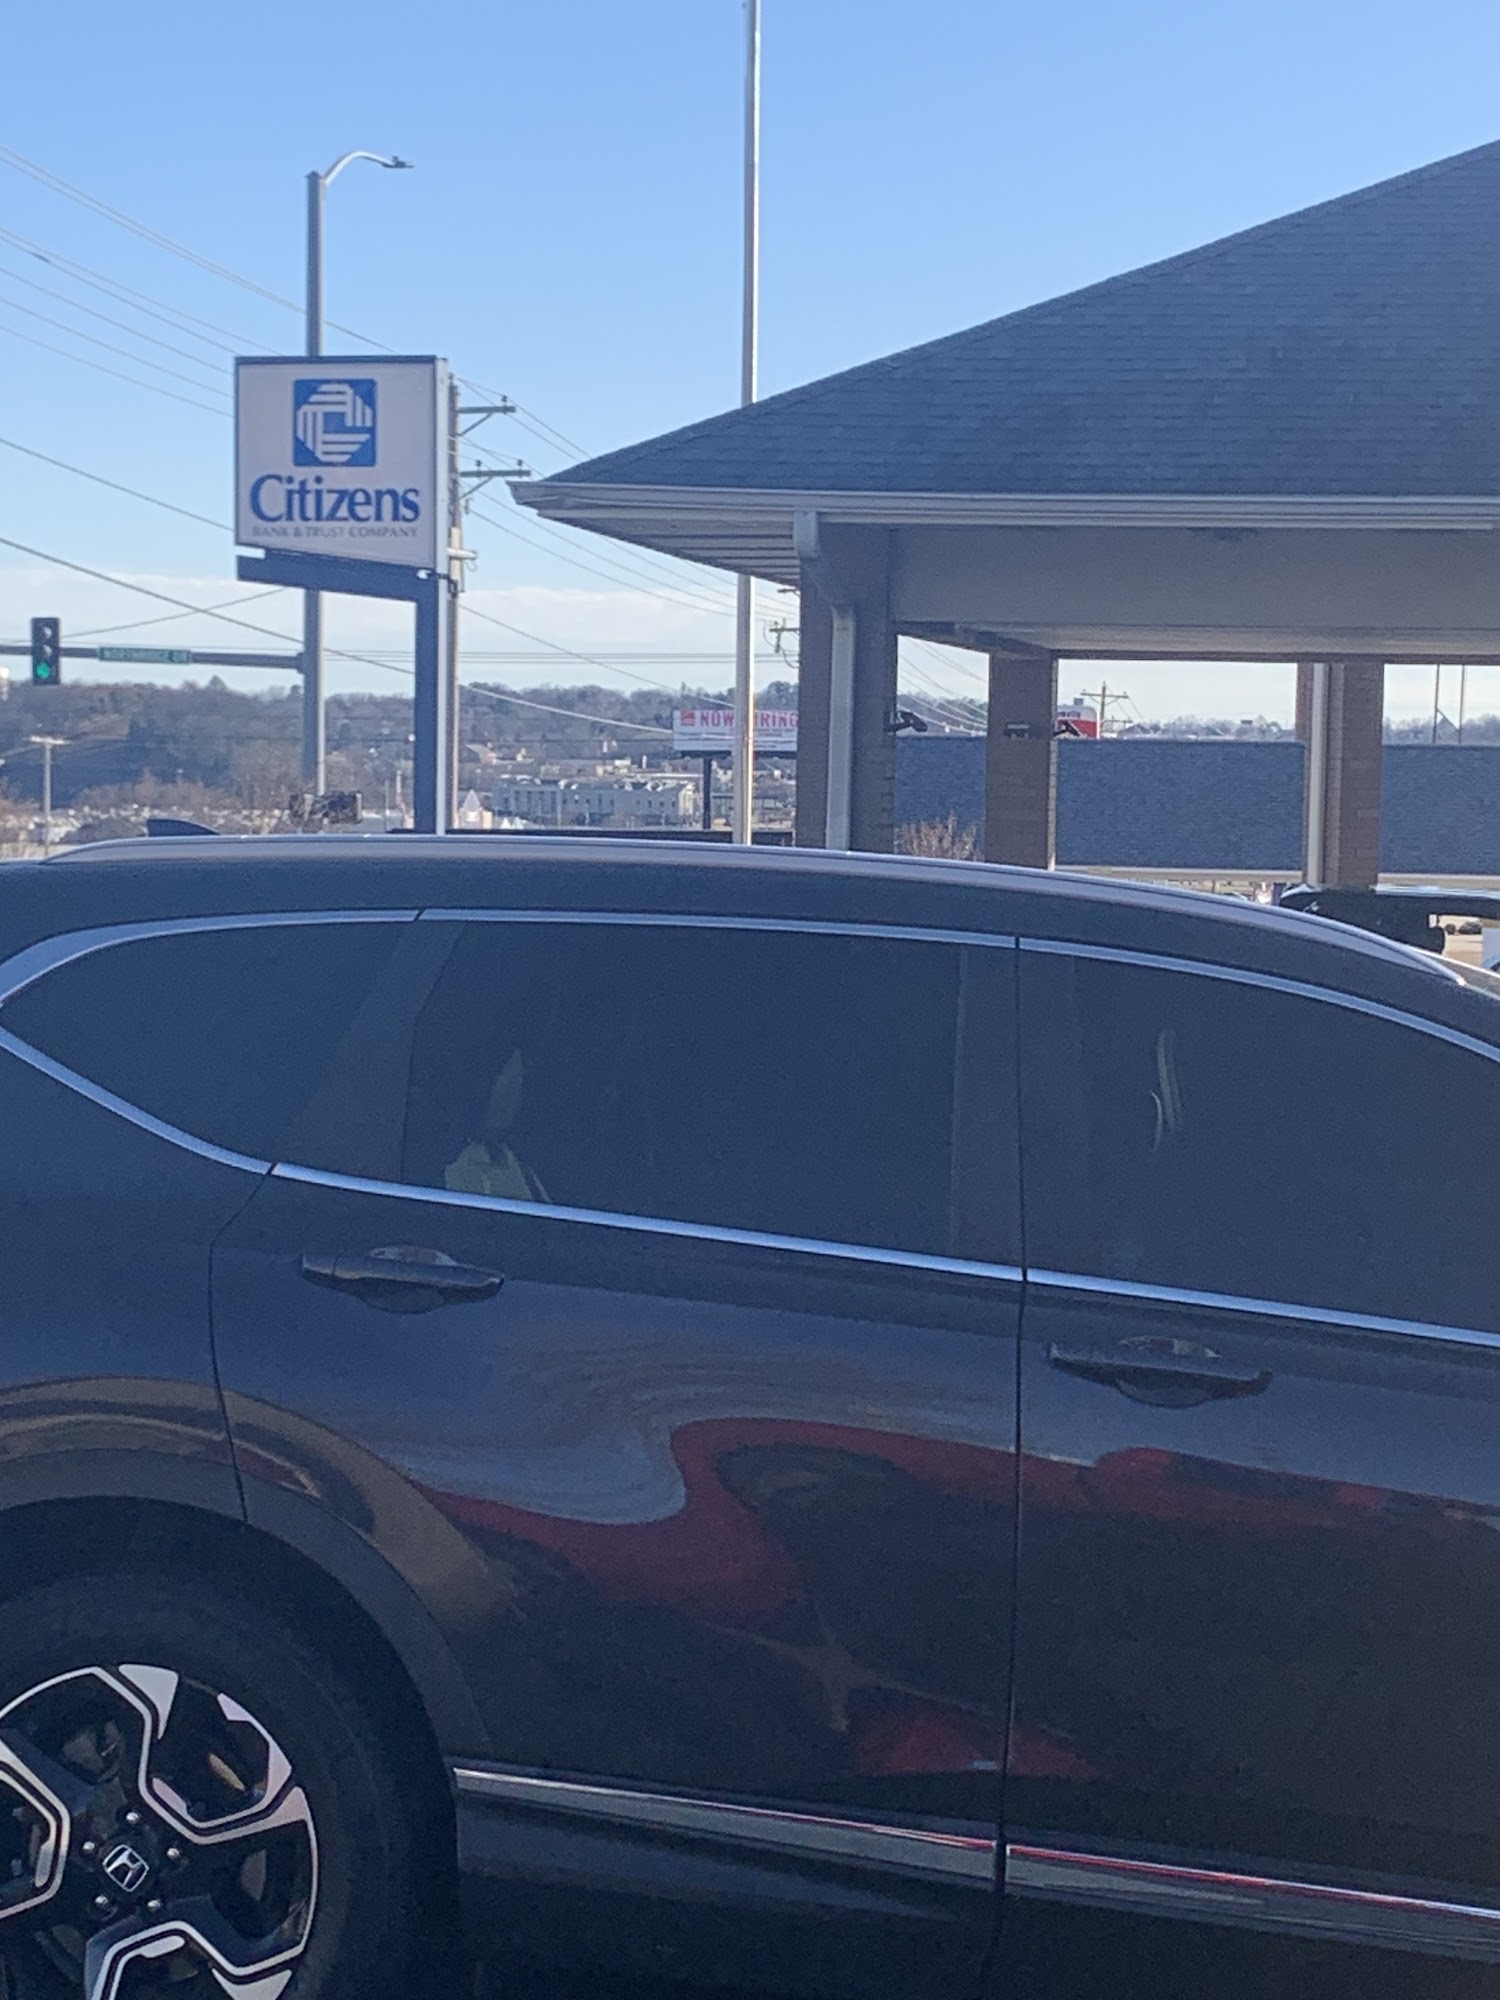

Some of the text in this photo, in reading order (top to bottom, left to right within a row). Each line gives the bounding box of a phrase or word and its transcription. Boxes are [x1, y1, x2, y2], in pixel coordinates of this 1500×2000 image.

[250, 474, 420, 522] Citizens
[252, 526, 291, 538] BANK
[306, 526, 344, 538] TRUST
[349, 526, 418, 538] COMPANY
[701, 711, 798, 727] NOW IRING
